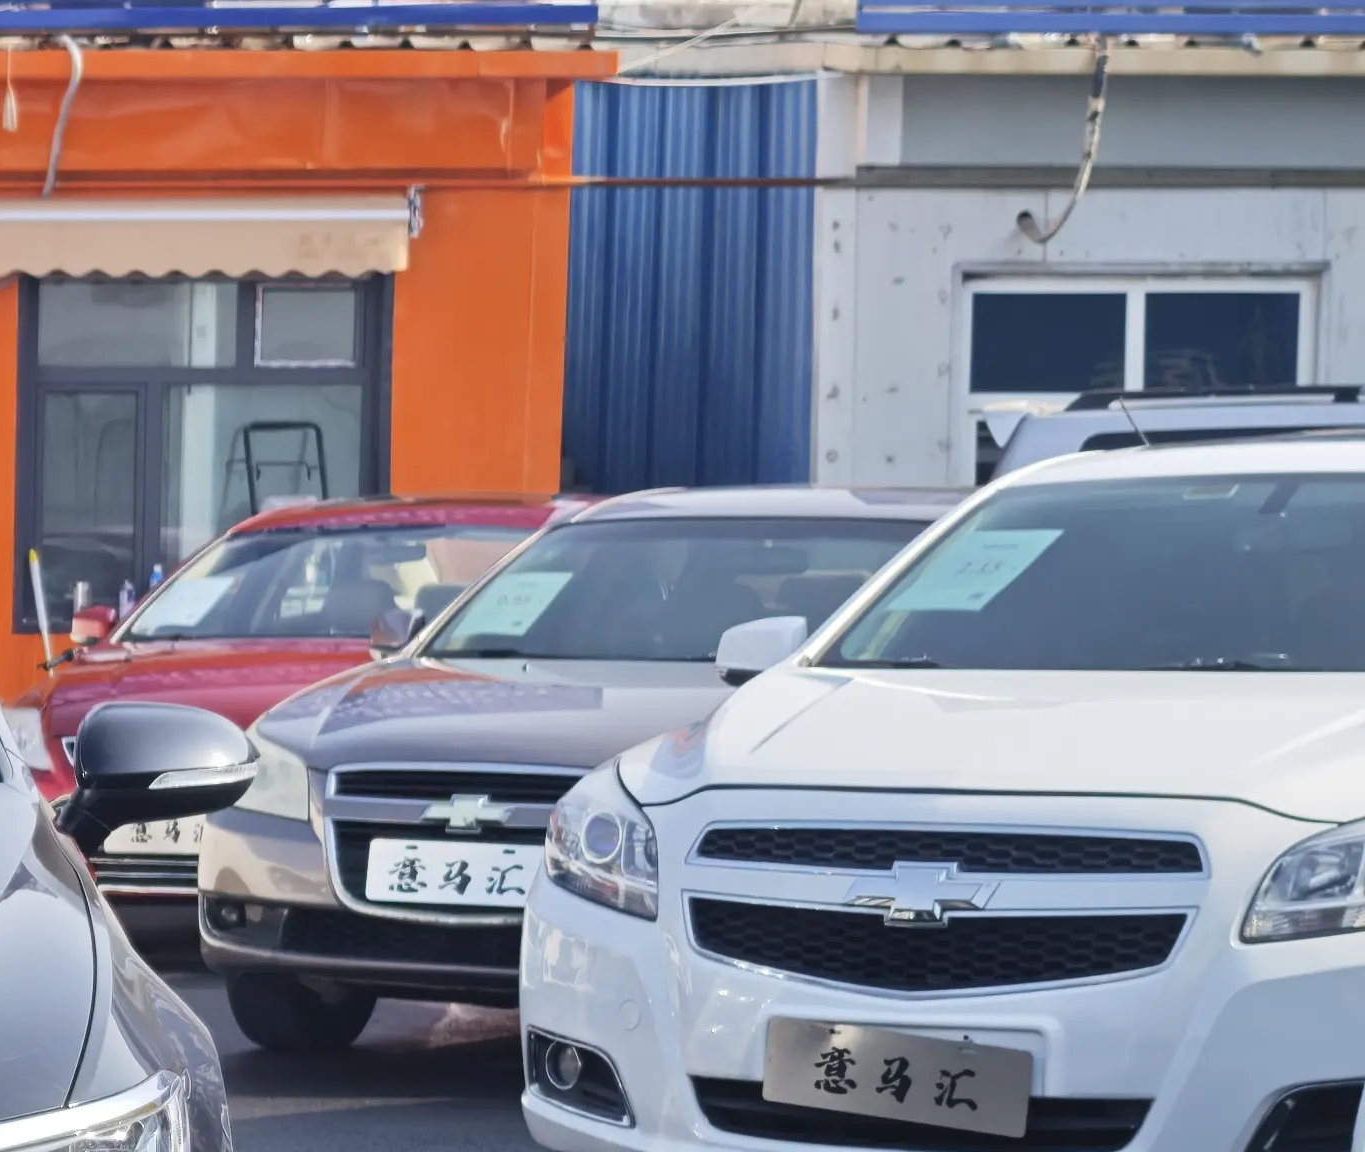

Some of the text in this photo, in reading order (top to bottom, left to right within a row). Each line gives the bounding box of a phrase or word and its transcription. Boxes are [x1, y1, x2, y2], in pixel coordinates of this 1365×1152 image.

[388, 856, 526, 895] 意马汇
[813, 1047, 978, 1112] 意马汇
